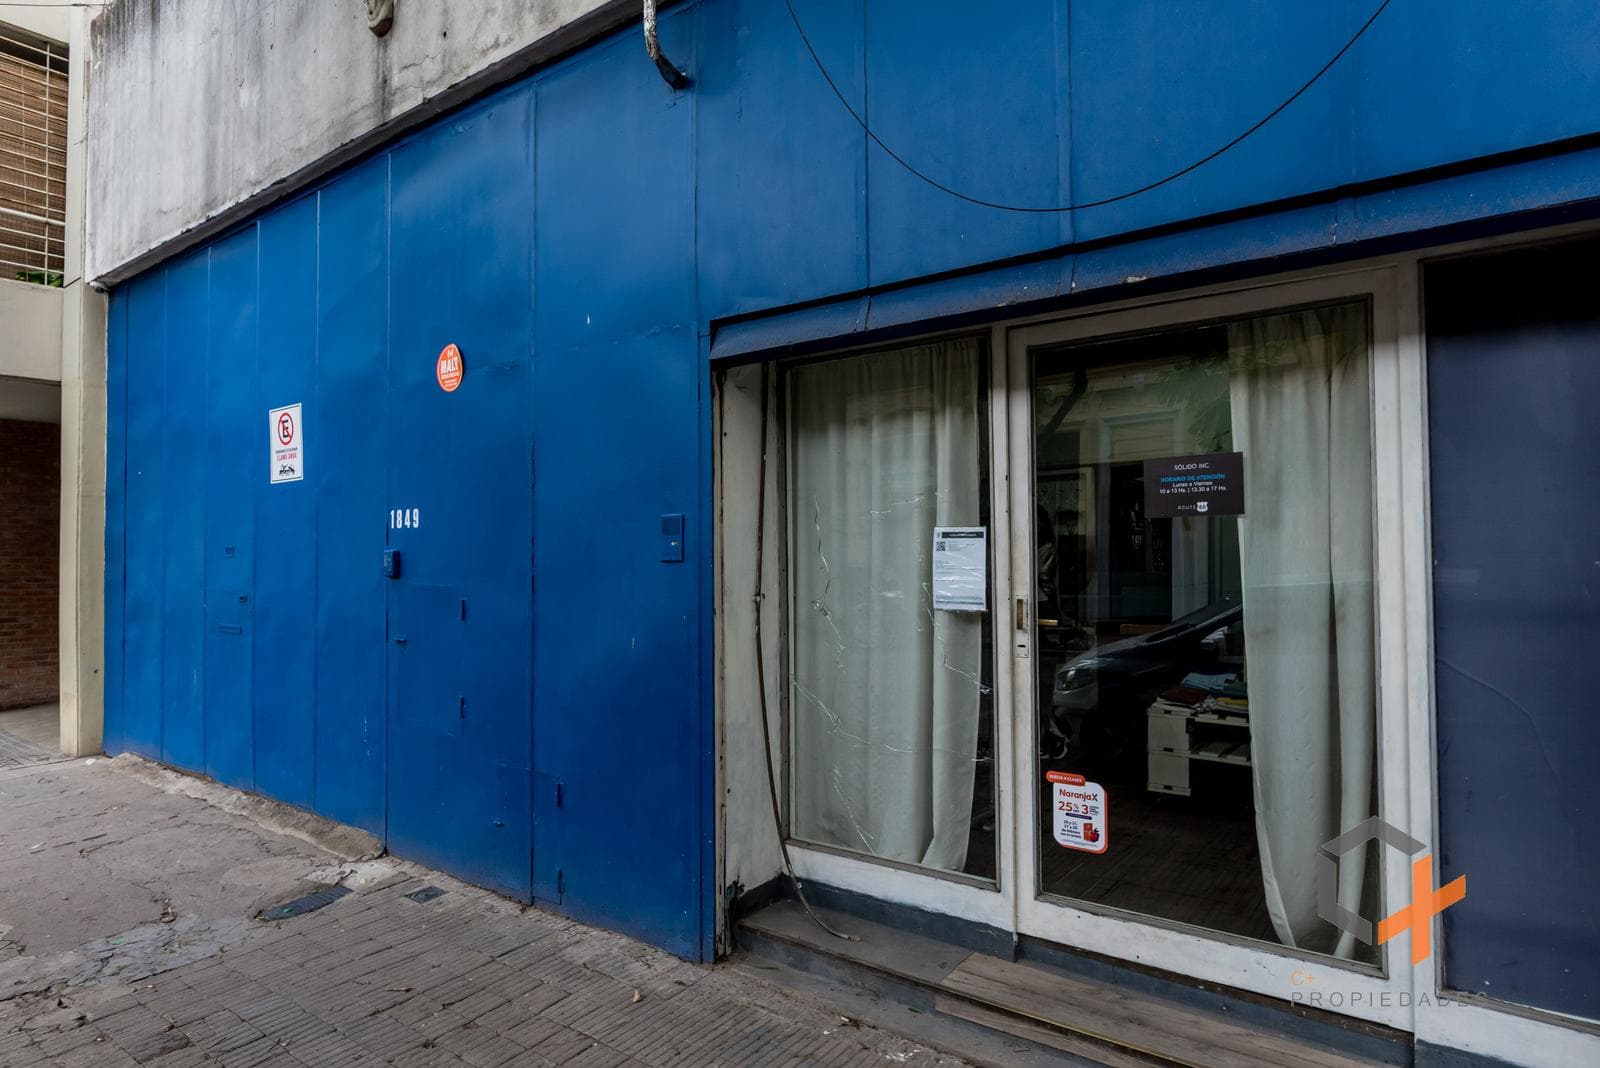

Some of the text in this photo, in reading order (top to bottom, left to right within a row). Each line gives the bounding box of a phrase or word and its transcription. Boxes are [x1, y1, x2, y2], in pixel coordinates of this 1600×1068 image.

[1196, 473, 1226, 481] ATENCIÓN
[391, 509, 419, 529] 1849
[1081, 804, 1089, 815] 3
